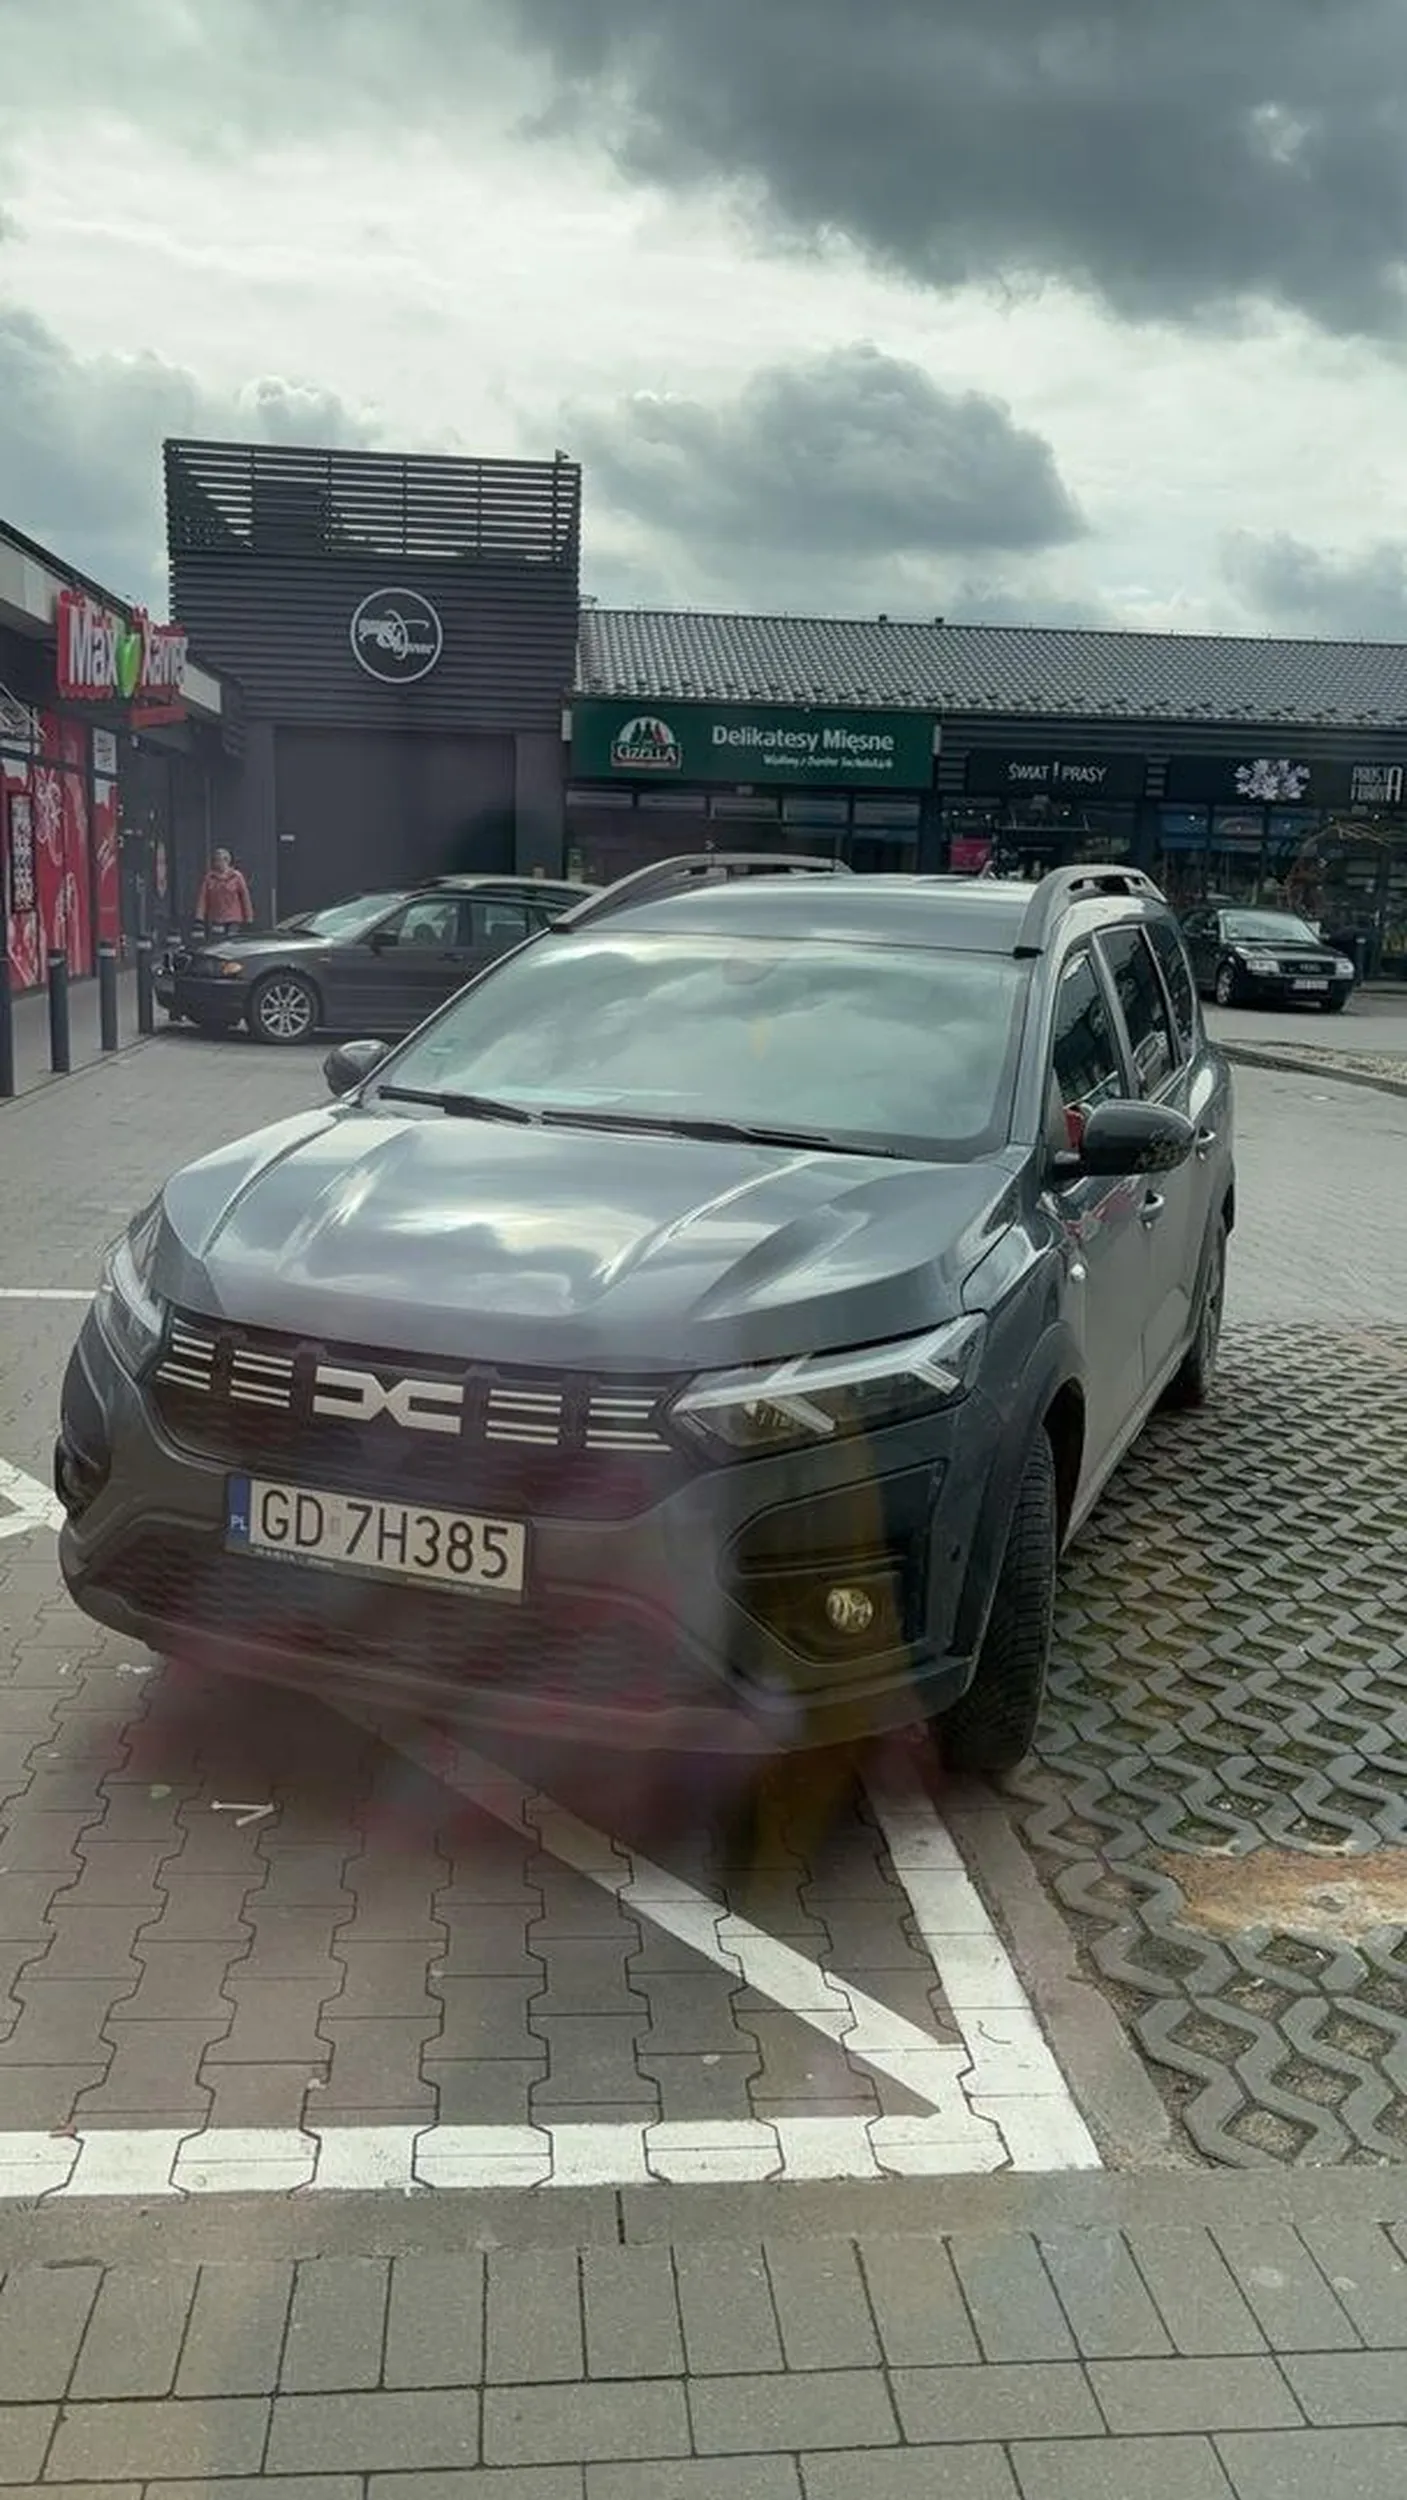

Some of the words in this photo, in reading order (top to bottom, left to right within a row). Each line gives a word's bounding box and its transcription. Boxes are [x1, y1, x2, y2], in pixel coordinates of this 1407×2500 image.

[69, 606, 118, 686] Max
[712, 726, 818, 751] Delikatesy
[823, 729, 894, 754] Mięsne
[1062, 765, 1107, 784] PRASY
[230, 1514, 249, 1531] PL
[261, 1489, 323, 1548] GD
[345, 1502, 509, 1579] 7H385
